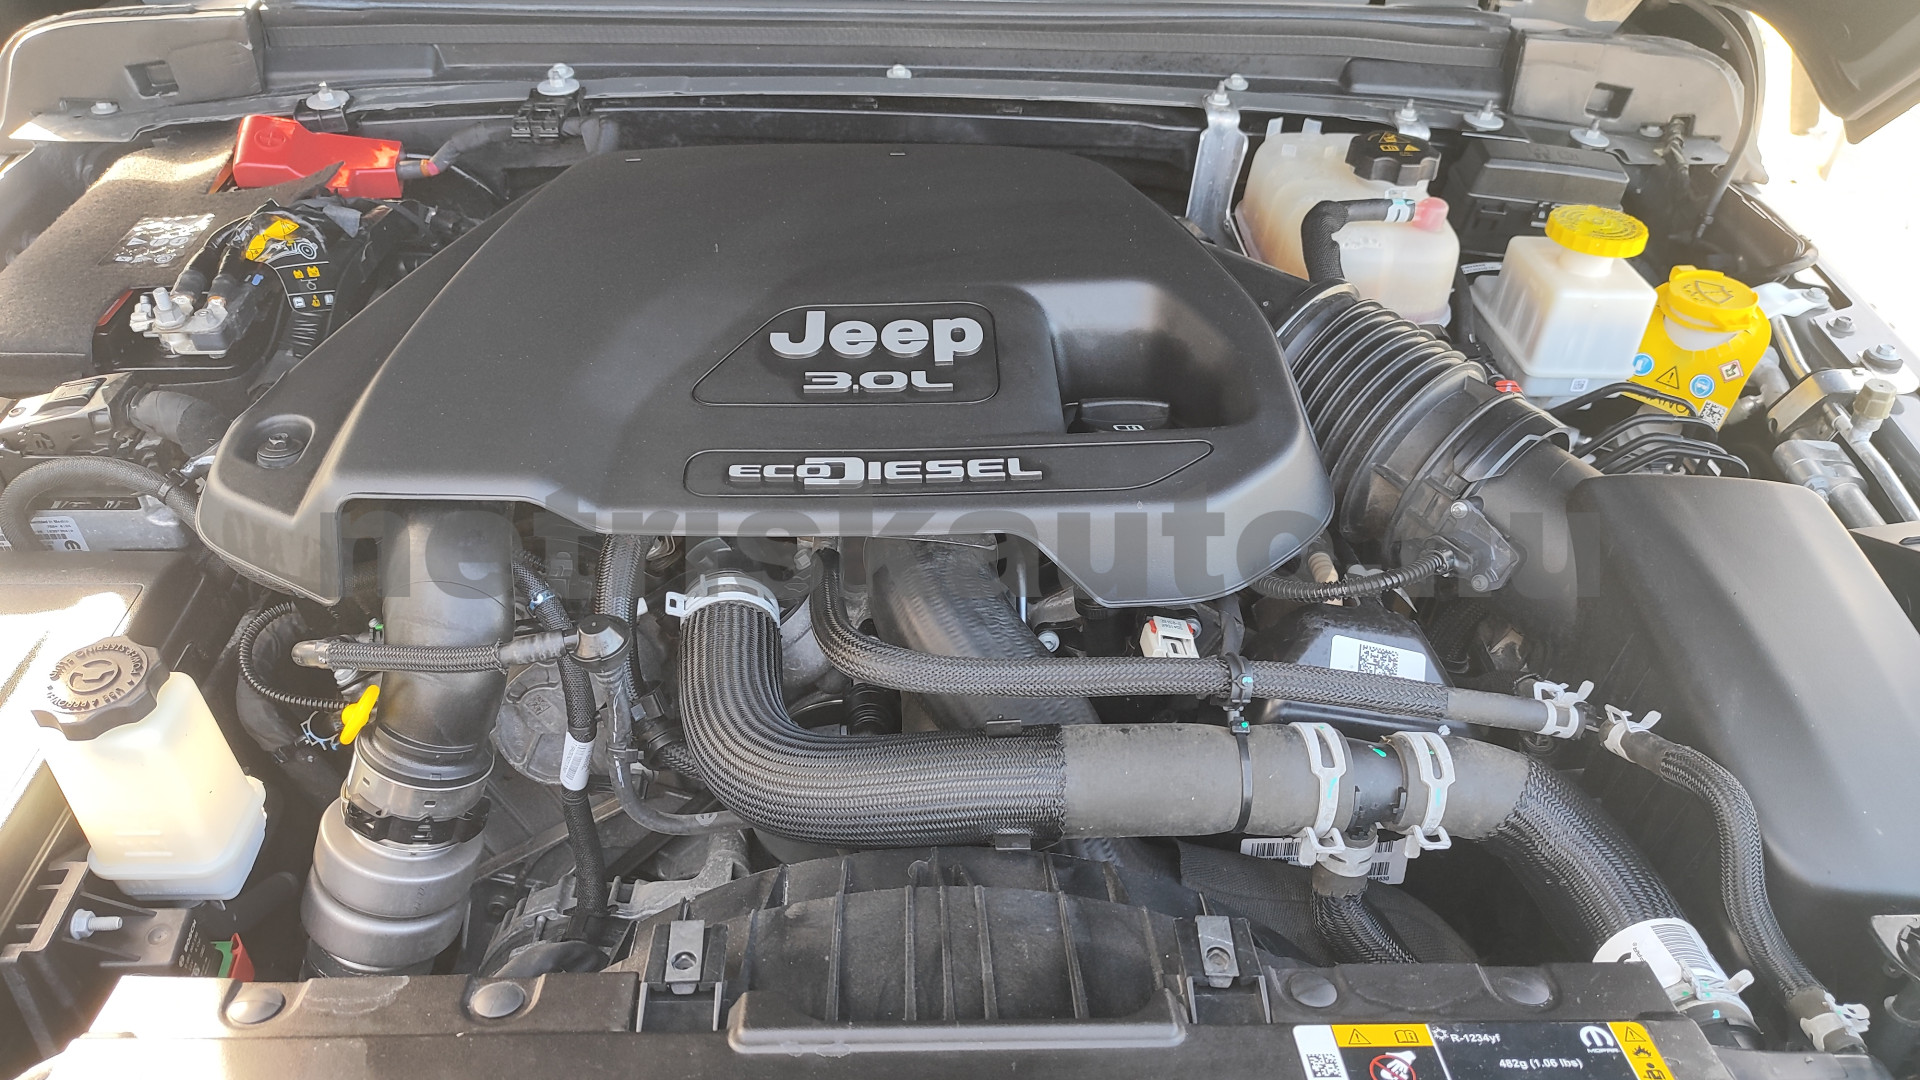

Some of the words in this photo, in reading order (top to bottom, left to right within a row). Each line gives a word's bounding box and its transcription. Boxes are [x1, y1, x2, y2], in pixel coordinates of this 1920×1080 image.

[769, 310, 984, 366] Jeep
[802, 371, 954, 394] 3.0L
[184, 918, 197, 953] BOSCH
[1449, 1032, 1501, 1046] R-1234yf
[1499, 1058, 1529, 1071] 482g
[1530, 1058, 1558, 1070] (1.06
[1560, 1058, 1584, 1070] lbs)
